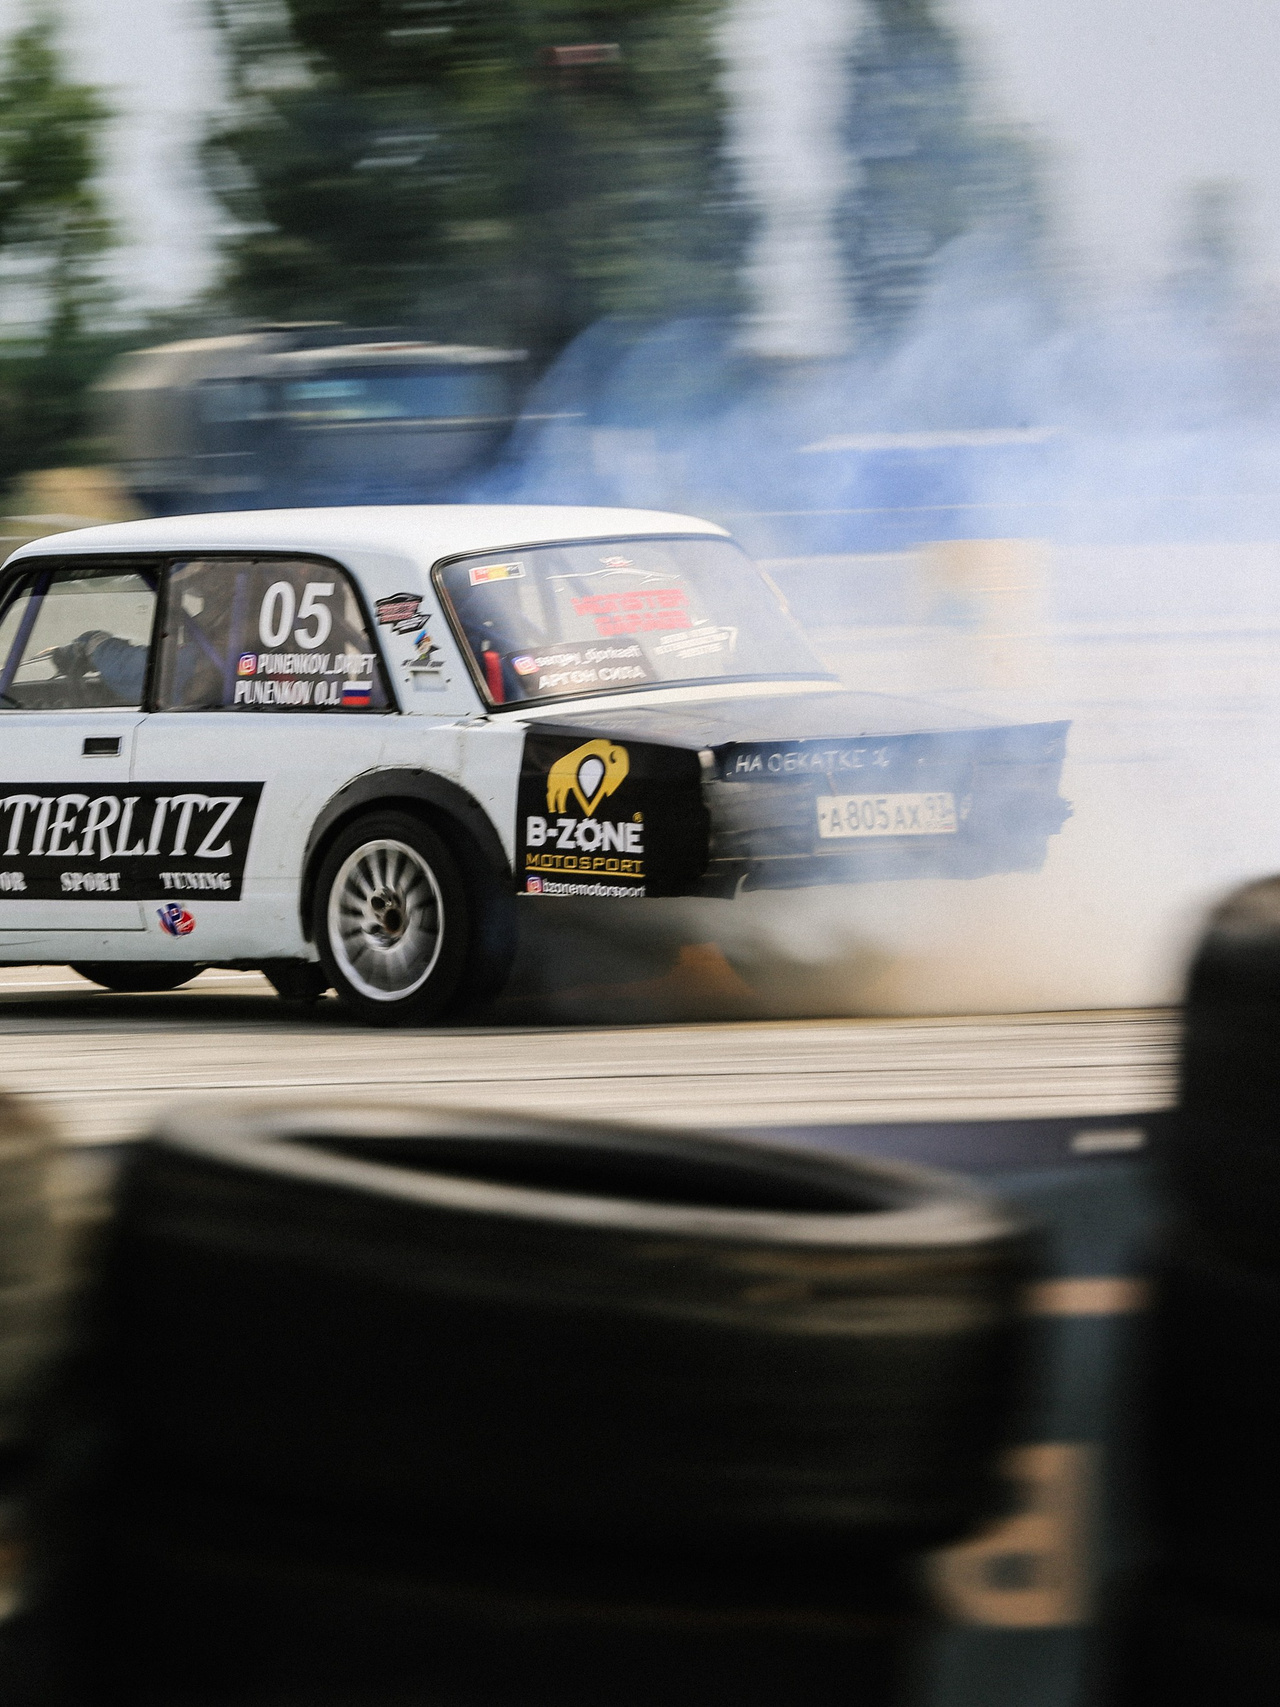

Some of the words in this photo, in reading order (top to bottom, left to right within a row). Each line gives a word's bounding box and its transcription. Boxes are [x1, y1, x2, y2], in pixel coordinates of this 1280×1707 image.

[259, 581, 335, 649] 05
[234, 680, 314, 704] PUNENKOV
[526, 816, 644, 853] B-ZONE
[525, 852, 644, 873] MOTOSPORT
[60, 872, 120, 891] SPORT
[159, 872, 232, 890] TUNING
